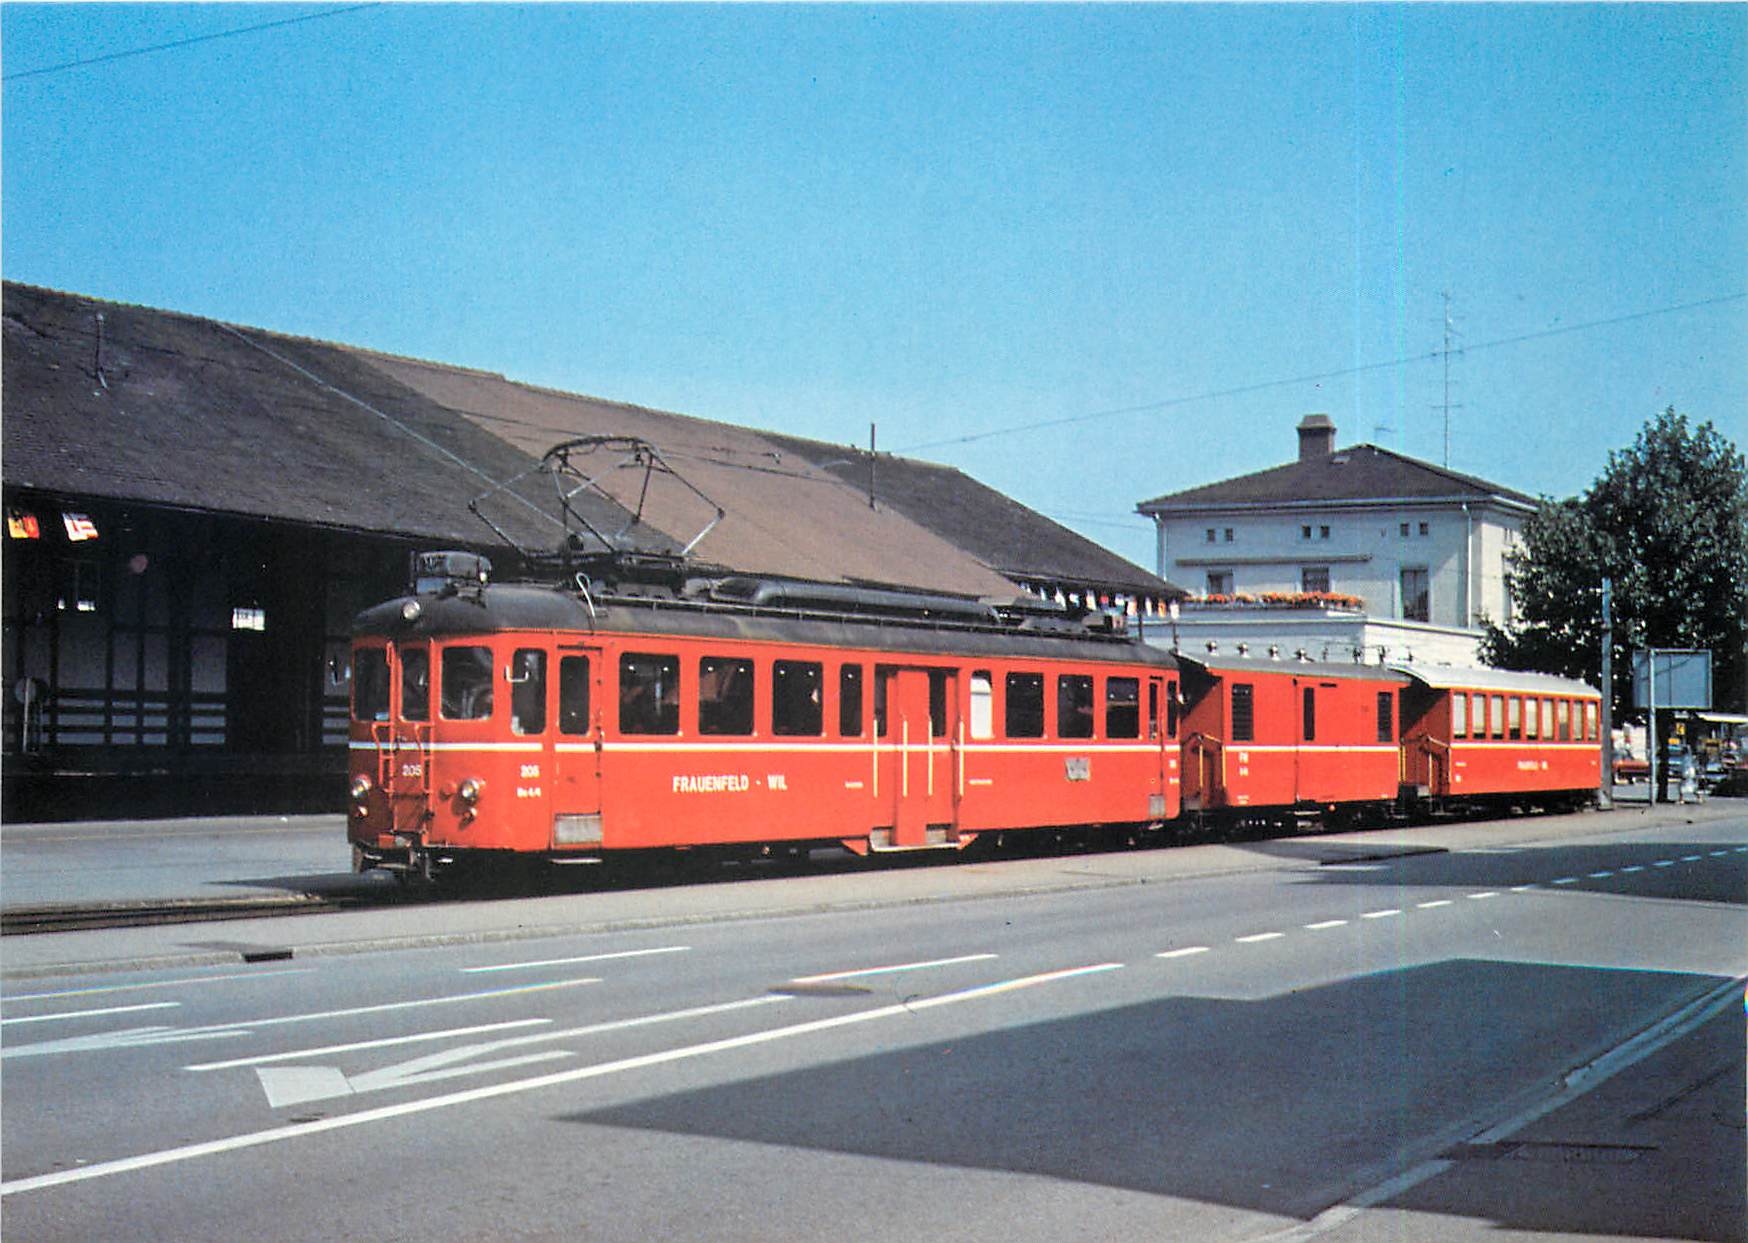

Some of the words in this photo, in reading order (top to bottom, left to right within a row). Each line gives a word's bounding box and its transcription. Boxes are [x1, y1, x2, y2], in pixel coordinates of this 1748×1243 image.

[402, 764, 422, 777] 205
[673, 774, 750, 793] FRAUENFELD
[767, 774, 788, 791] WIL
